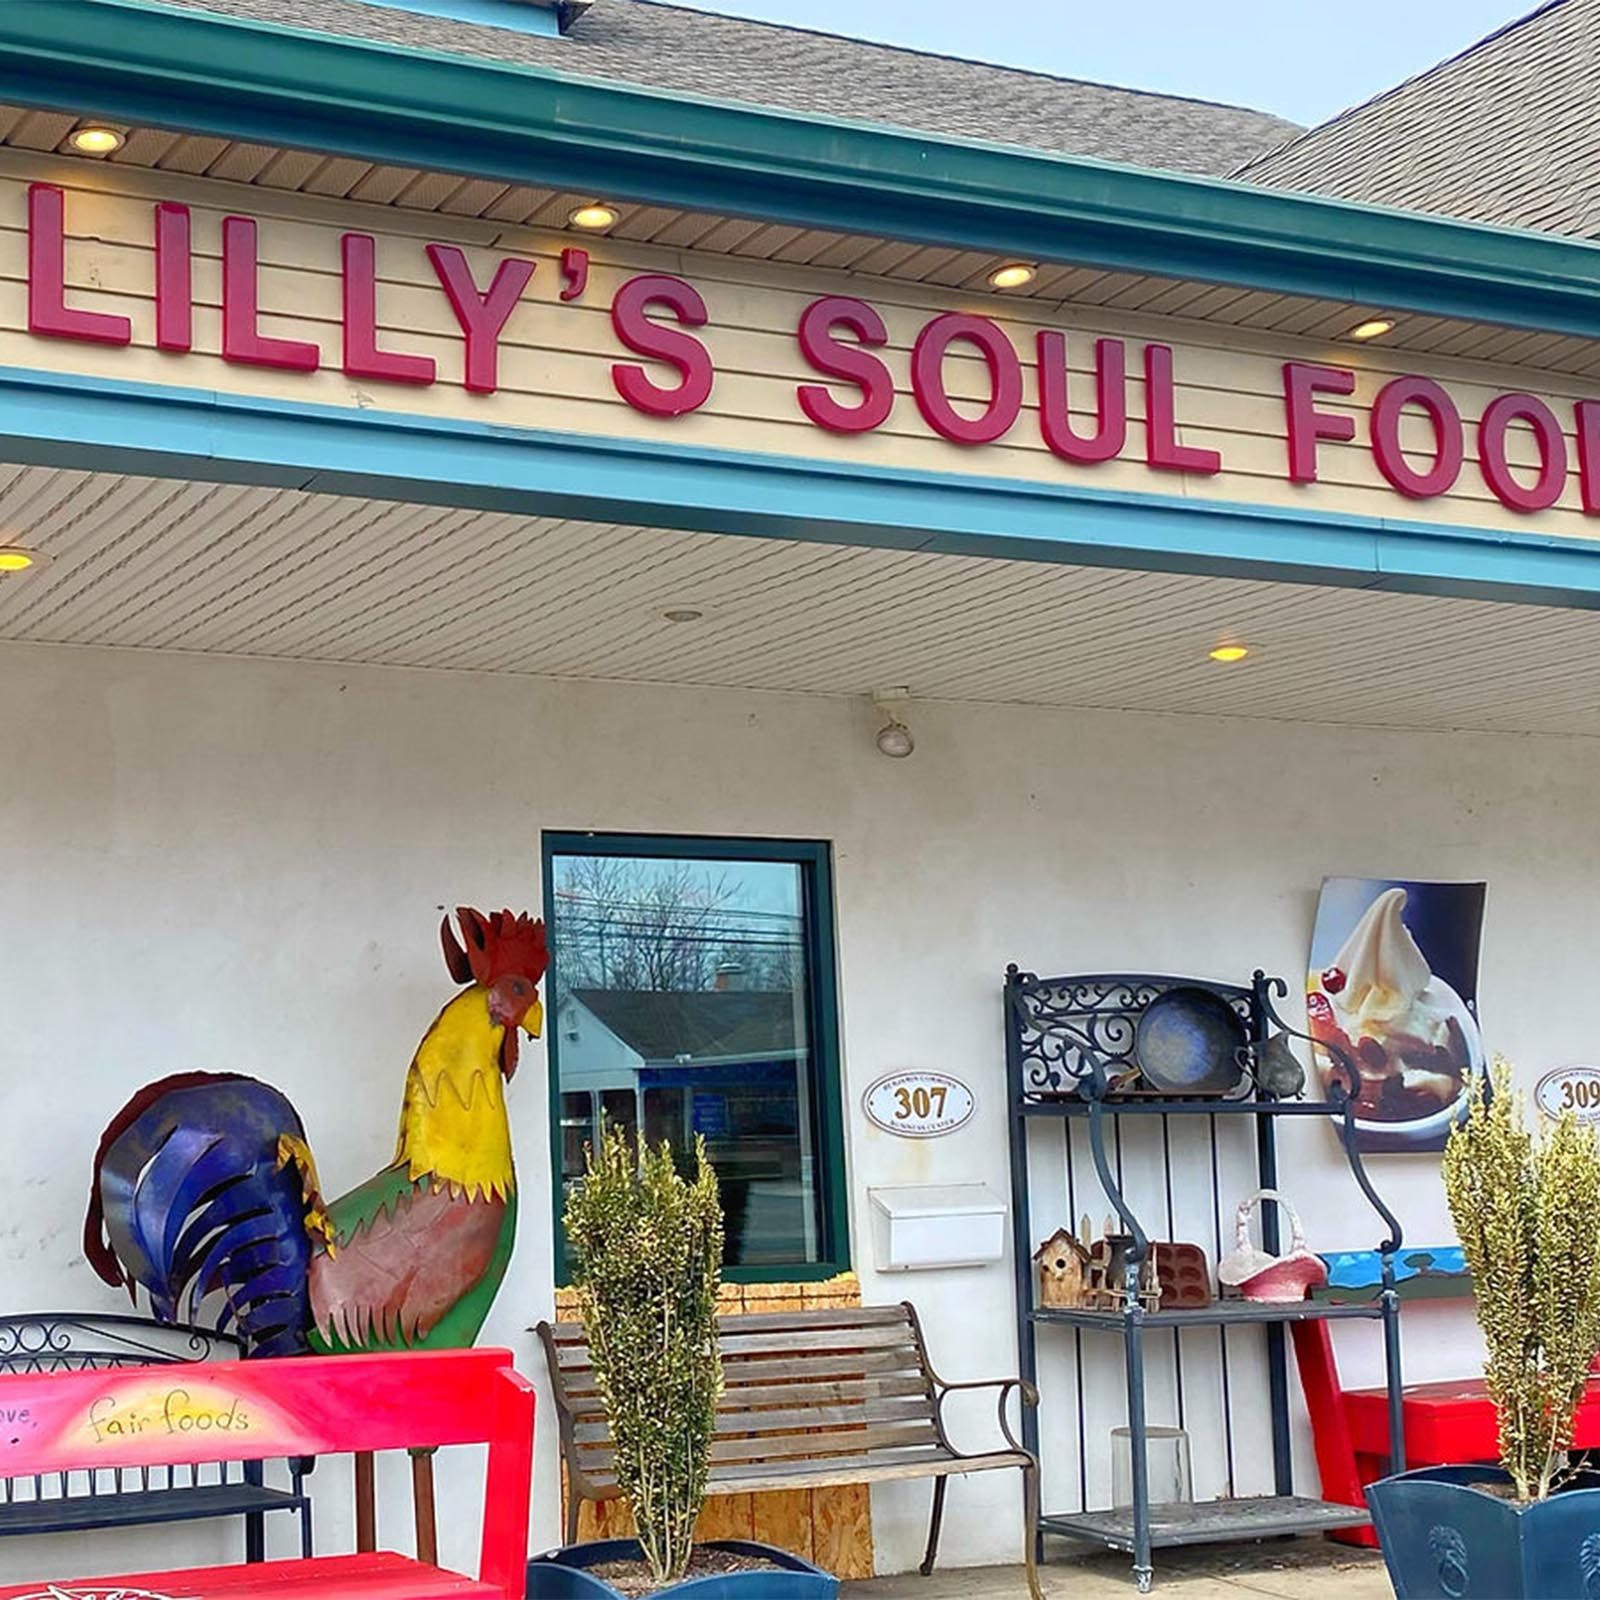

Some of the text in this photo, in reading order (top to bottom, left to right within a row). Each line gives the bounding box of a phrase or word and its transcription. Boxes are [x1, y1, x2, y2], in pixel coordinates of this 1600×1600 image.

[28, 183, 714, 418] LILLY'S
[797, 295, 1221, 476] SOUL
[894, 1087, 947, 1119] 307
[1561, 1080, 1600, 1109] 309
[89, 1388, 249, 1444] fair foods
